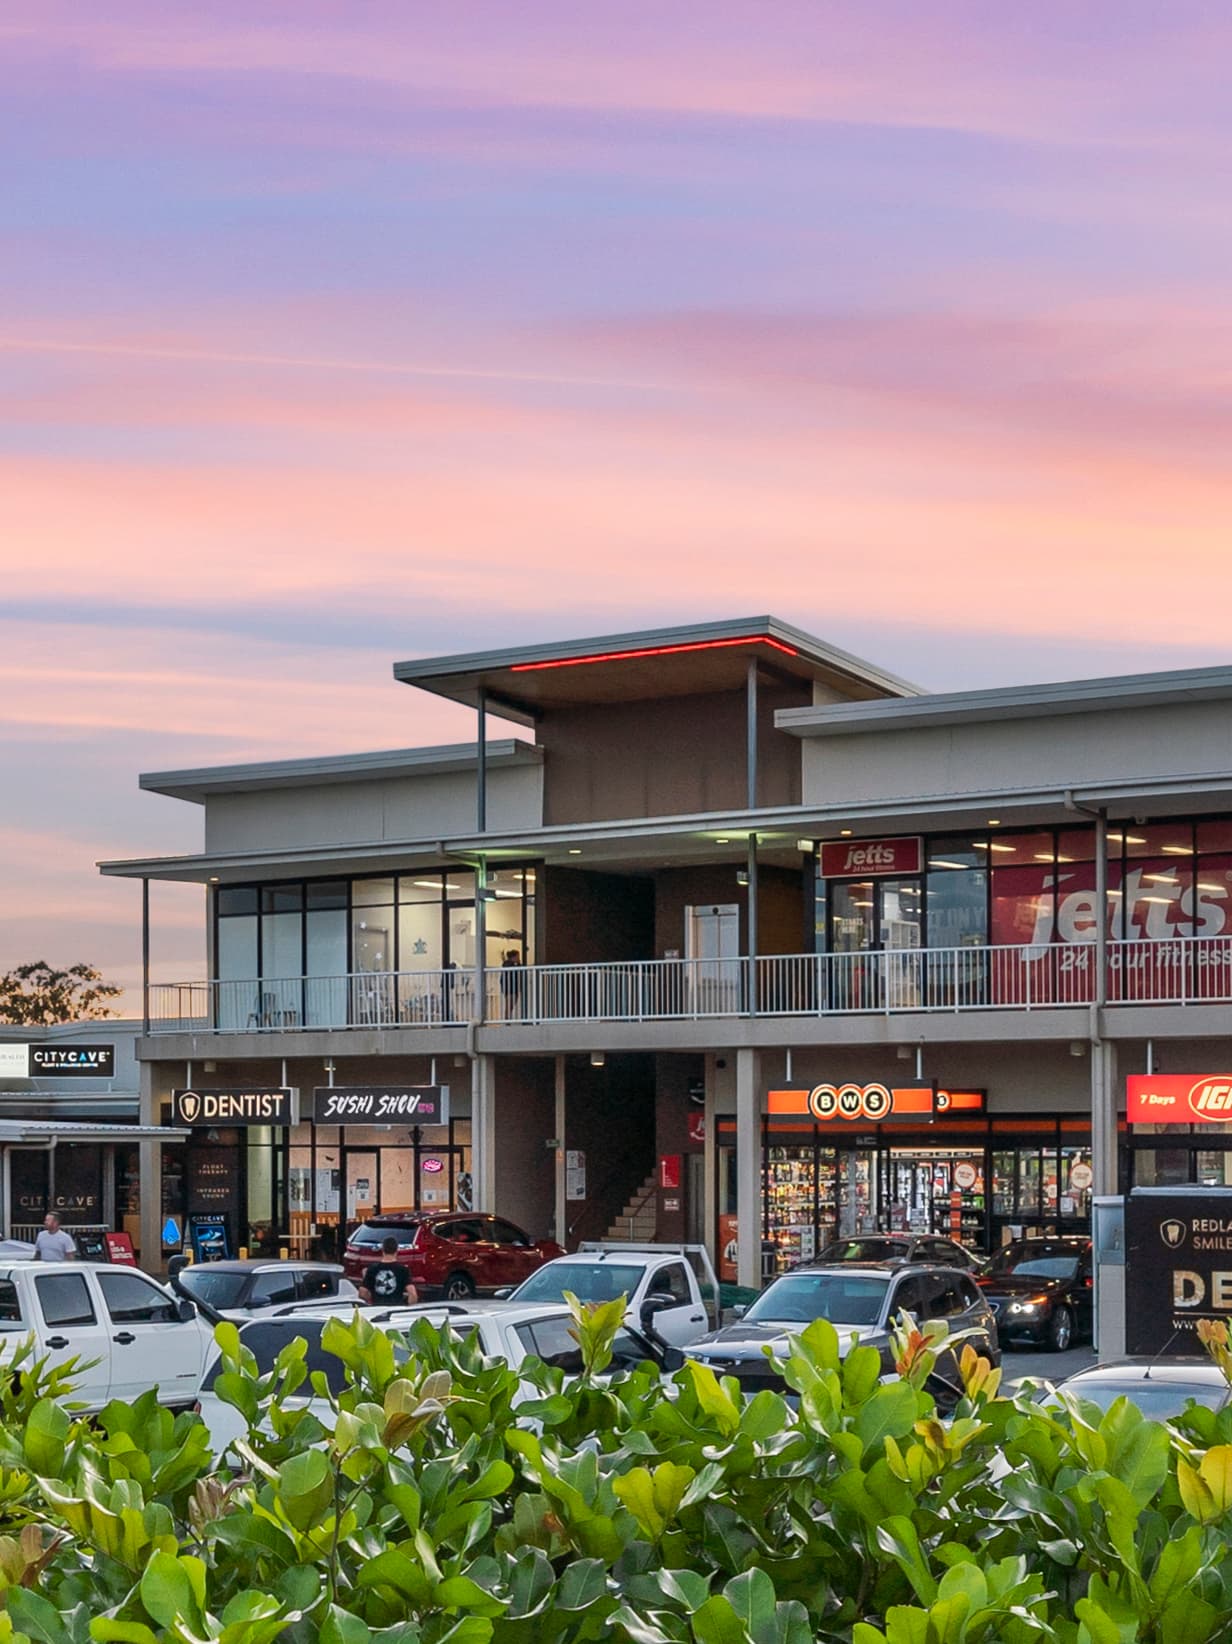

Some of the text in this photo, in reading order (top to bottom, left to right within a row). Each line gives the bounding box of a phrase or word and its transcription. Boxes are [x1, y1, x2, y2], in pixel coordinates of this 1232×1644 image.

[844, 844, 895, 870] jetts
[1021, 867, 1229, 961] jetts
[1060, 951, 1088, 971] 24
[1105, 949, 1150, 969] our
[204, 1094, 284, 1117] DENTIST
[325, 1095, 373, 1116] SUSHI
[375, 1095, 421, 1116] SHOU
[1140, 1094, 1176, 1105] 7 Days
